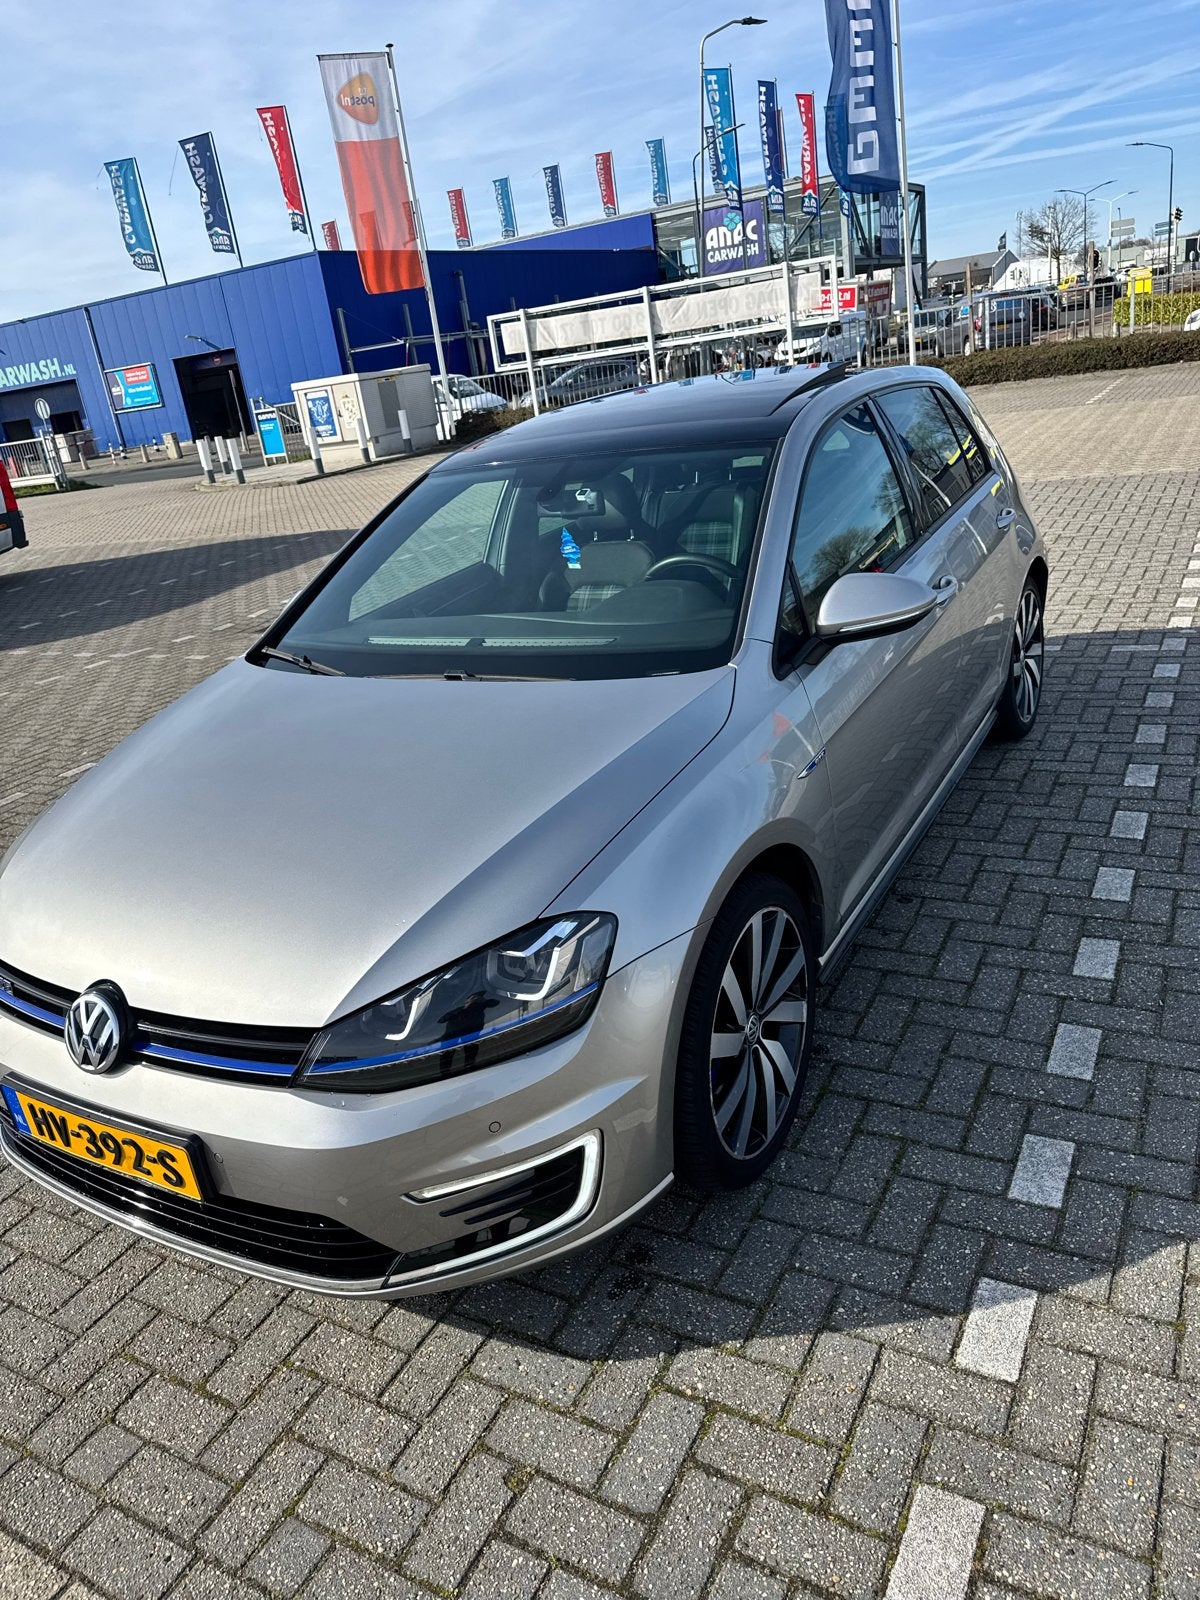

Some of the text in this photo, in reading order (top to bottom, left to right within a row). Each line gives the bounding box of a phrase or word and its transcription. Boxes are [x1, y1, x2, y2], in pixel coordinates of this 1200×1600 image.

[706, 219, 758, 249] ANAC
[13, 1112, 27, 1127] NL
[28, 1102, 186, 1188] HV-392-S
